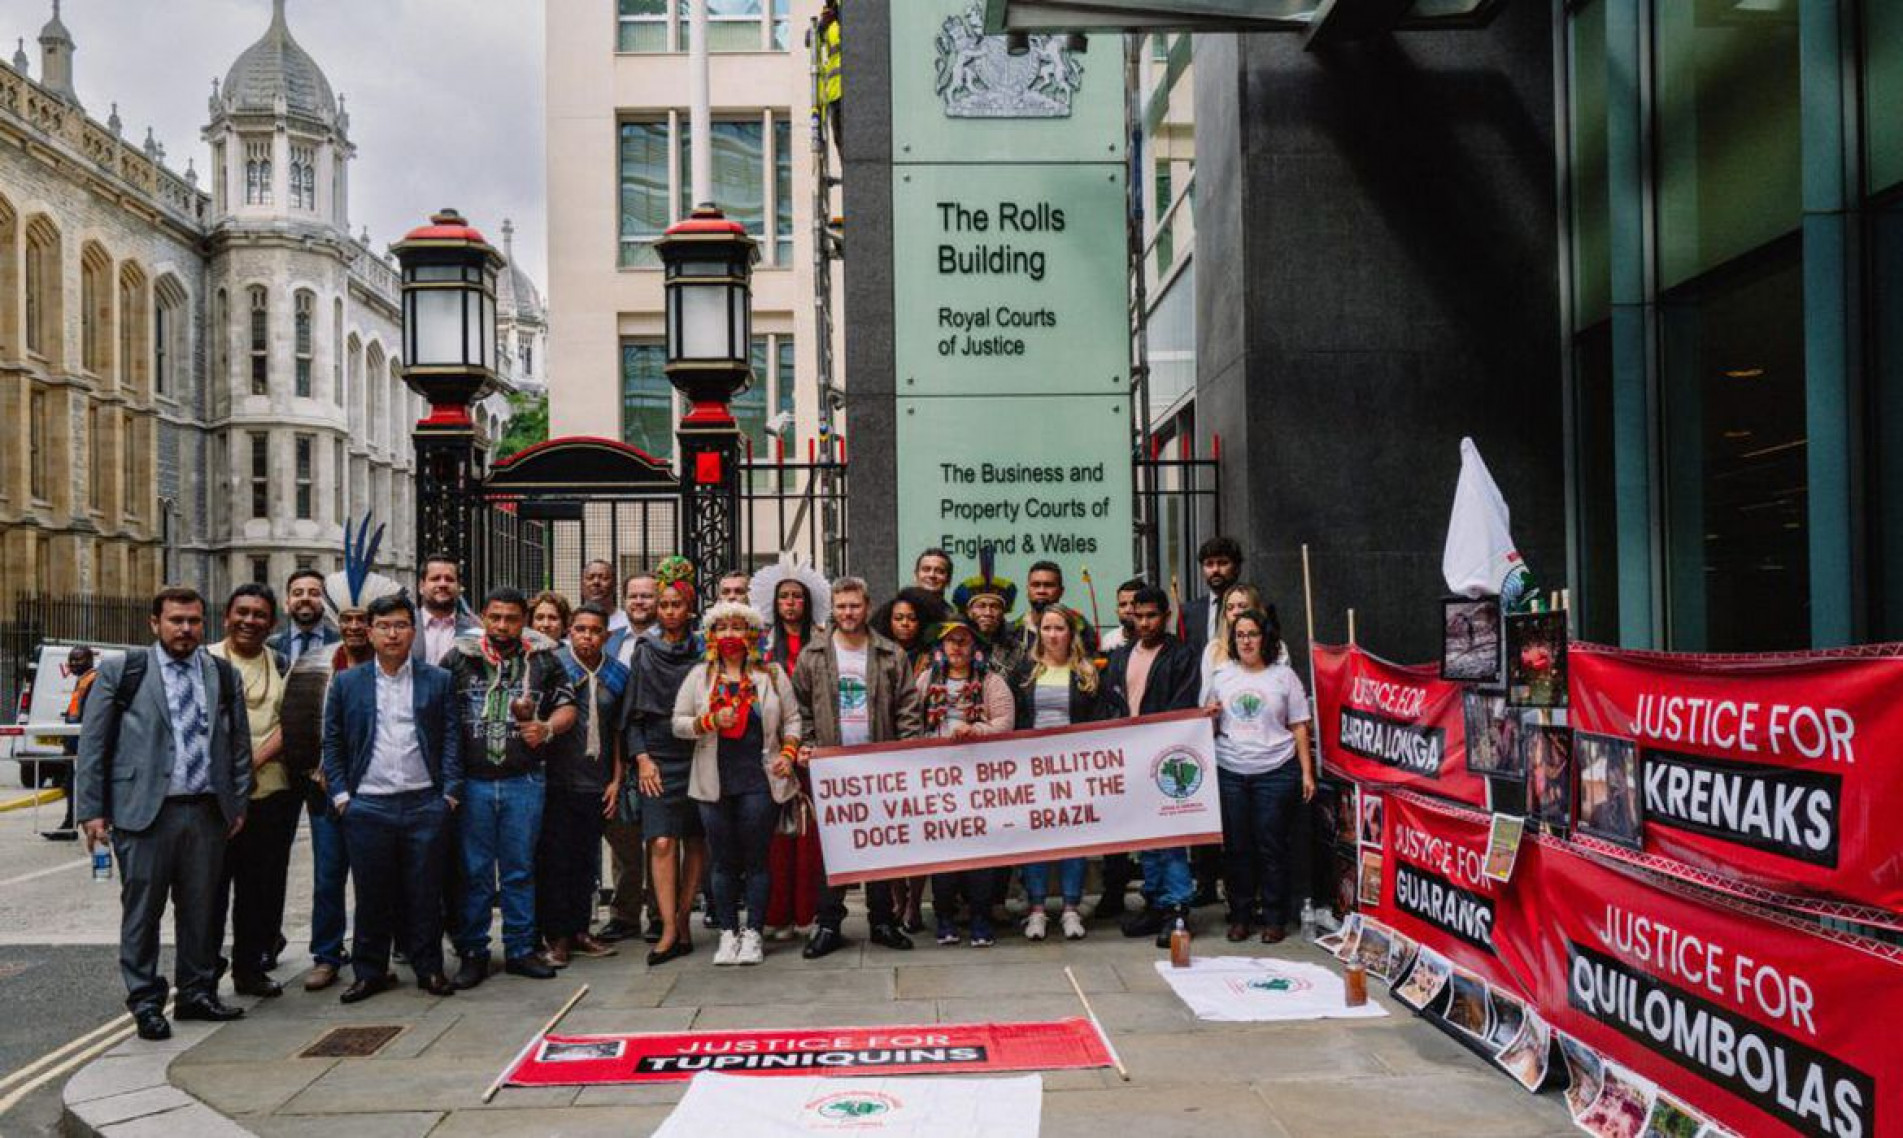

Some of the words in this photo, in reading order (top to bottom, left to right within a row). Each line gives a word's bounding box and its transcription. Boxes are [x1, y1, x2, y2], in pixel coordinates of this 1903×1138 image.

[937, 202, 989, 232] The
[999, 202, 1066, 232] Rolls
[938, 245, 1046, 281] Building
[938, 307, 990, 333] Royal
[996, 306, 1057, 327] Courts
[938, 335, 956, 356] of
[961, 335, 1025, 356] Justice
[941, 463, 975, 483] The
[981, 463, 1064, 483] Business
[1070, 462, 1104, 482] and
[941, 499, 1019, 523] Property
[1025, 498, 1087, 518] Courts
[1092, 497, 1109, 517] of
[941, 534, 1016, 560] England
[1021, 535, 1036, 554] &
[1041, 533, 1097, 553] Wales
[1396, 686, 1426, 716] FOR
[1630, 694, 1758, 752] JUSTICE
[1769, 706, 1855, 763] FOR
[1384, 725, 1439, 772] LONGA
[819, 774, 907, 800] JUSTICE
[921, 764, 962, 789] FOR
[977, 760, 1018, 782] BHP
[1030, 748, 1125, 777] BILLITON
[824, 803, 868, 826] AND
[882, 792, 957, 820] VALE'S
[970, 785, 1037, 810] CRIME
[1050, 780, 1073, 801] IN
[1085, 774, 1126, 797] THE
[1643, 760, 1833, 851] KRENAKS
[853, 824, 910, 850] DOCE
[924, 815, 987, 841] RIVER
[1030, 803, 1101, 831] BRAZIL
[1395, 825, 1452, 873] JUSTICE
[1600, 904, 1724, 995] JUSTICE
[1735, 955, 1816, 1034] FOR
[649, 1047, 979, 1071] TUPINIQUINS
[678, 1038, 850, 1053] JUSTICE
[868, 1034, 950, 1047] FOR
[1572, 956, 1863, 1138] QUILOMBOLAS
